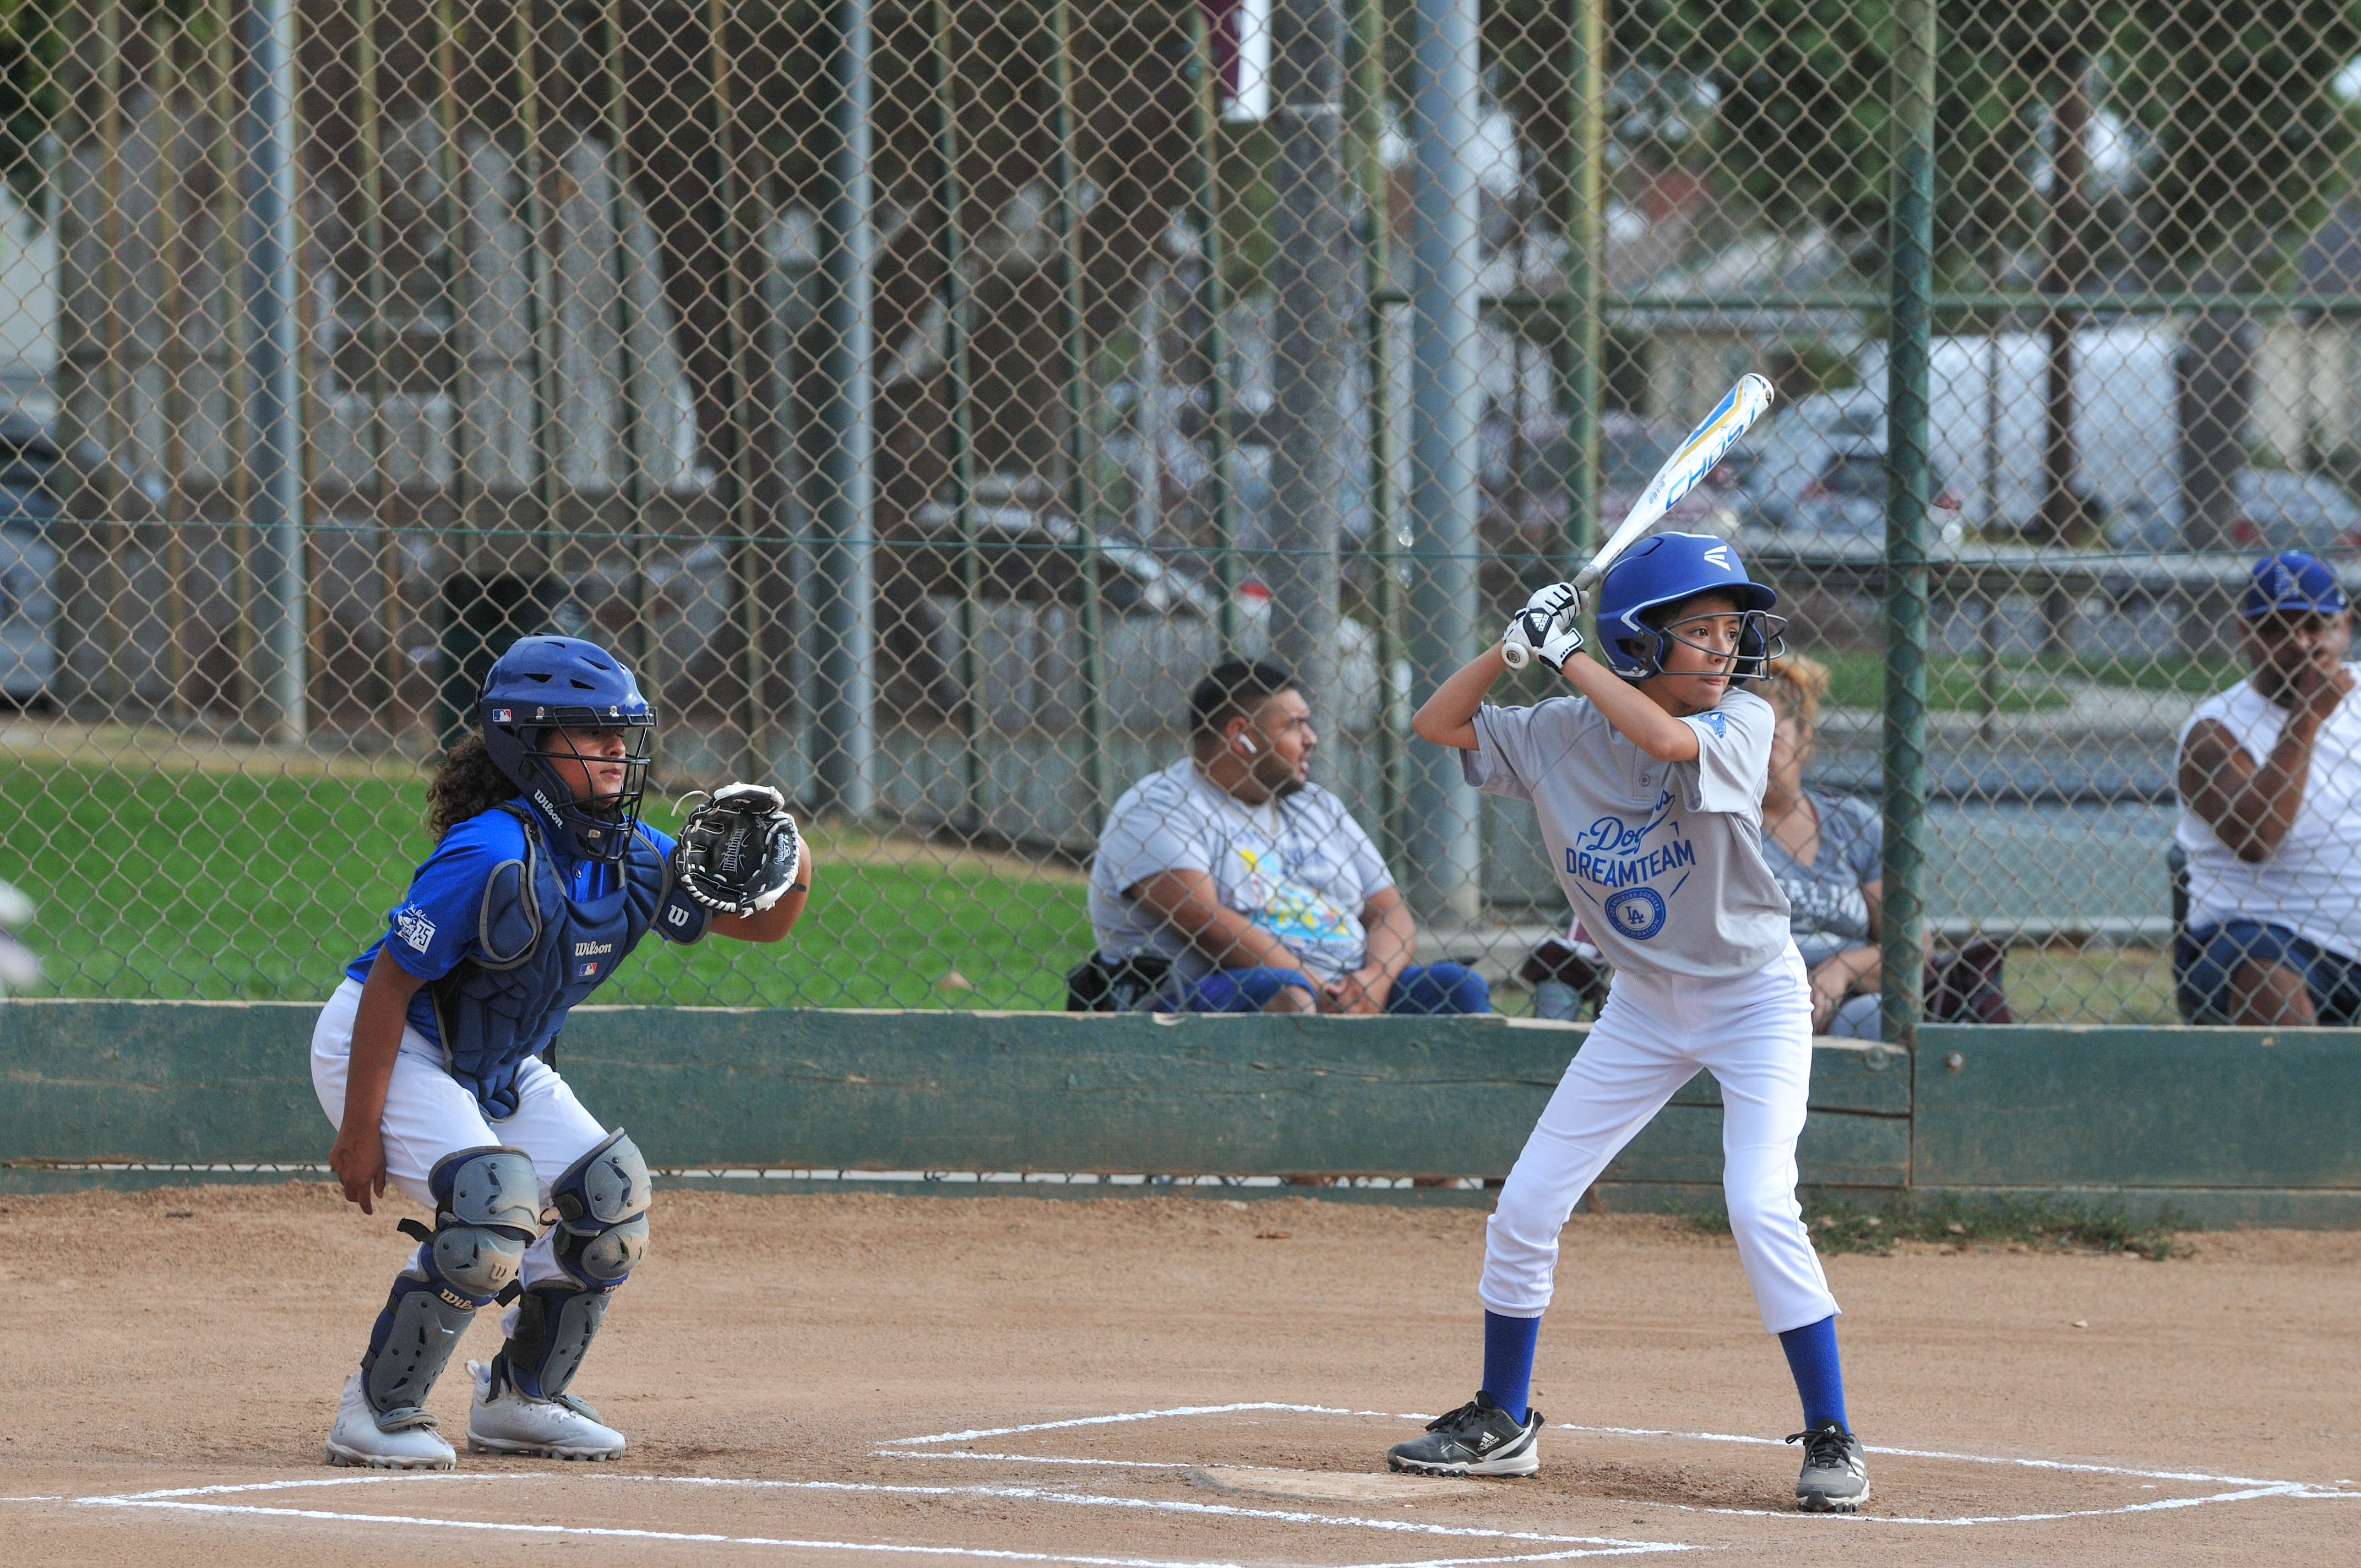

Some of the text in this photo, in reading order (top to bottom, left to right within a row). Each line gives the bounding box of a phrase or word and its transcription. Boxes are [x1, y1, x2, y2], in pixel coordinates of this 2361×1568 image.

[534, 788, 564, 830] Wilson
[773, 831, 789, 865] Rawlings
[1566, 839, 1696, 888] DREAMTEAM
[1612, 892, 1638, 907] ANGELES
[1639, 891, 1661, 912] DODGERS
[667, 904, 689, 927] W
[1625, 905, 1645, 924] LA
[412, 924, 431, 946] 75
[1616, 918, 1660, 937] FOUNDATION
[575, 940, 612, 956] Wilson
[1477, 1436, 1500, 1452] adidas
